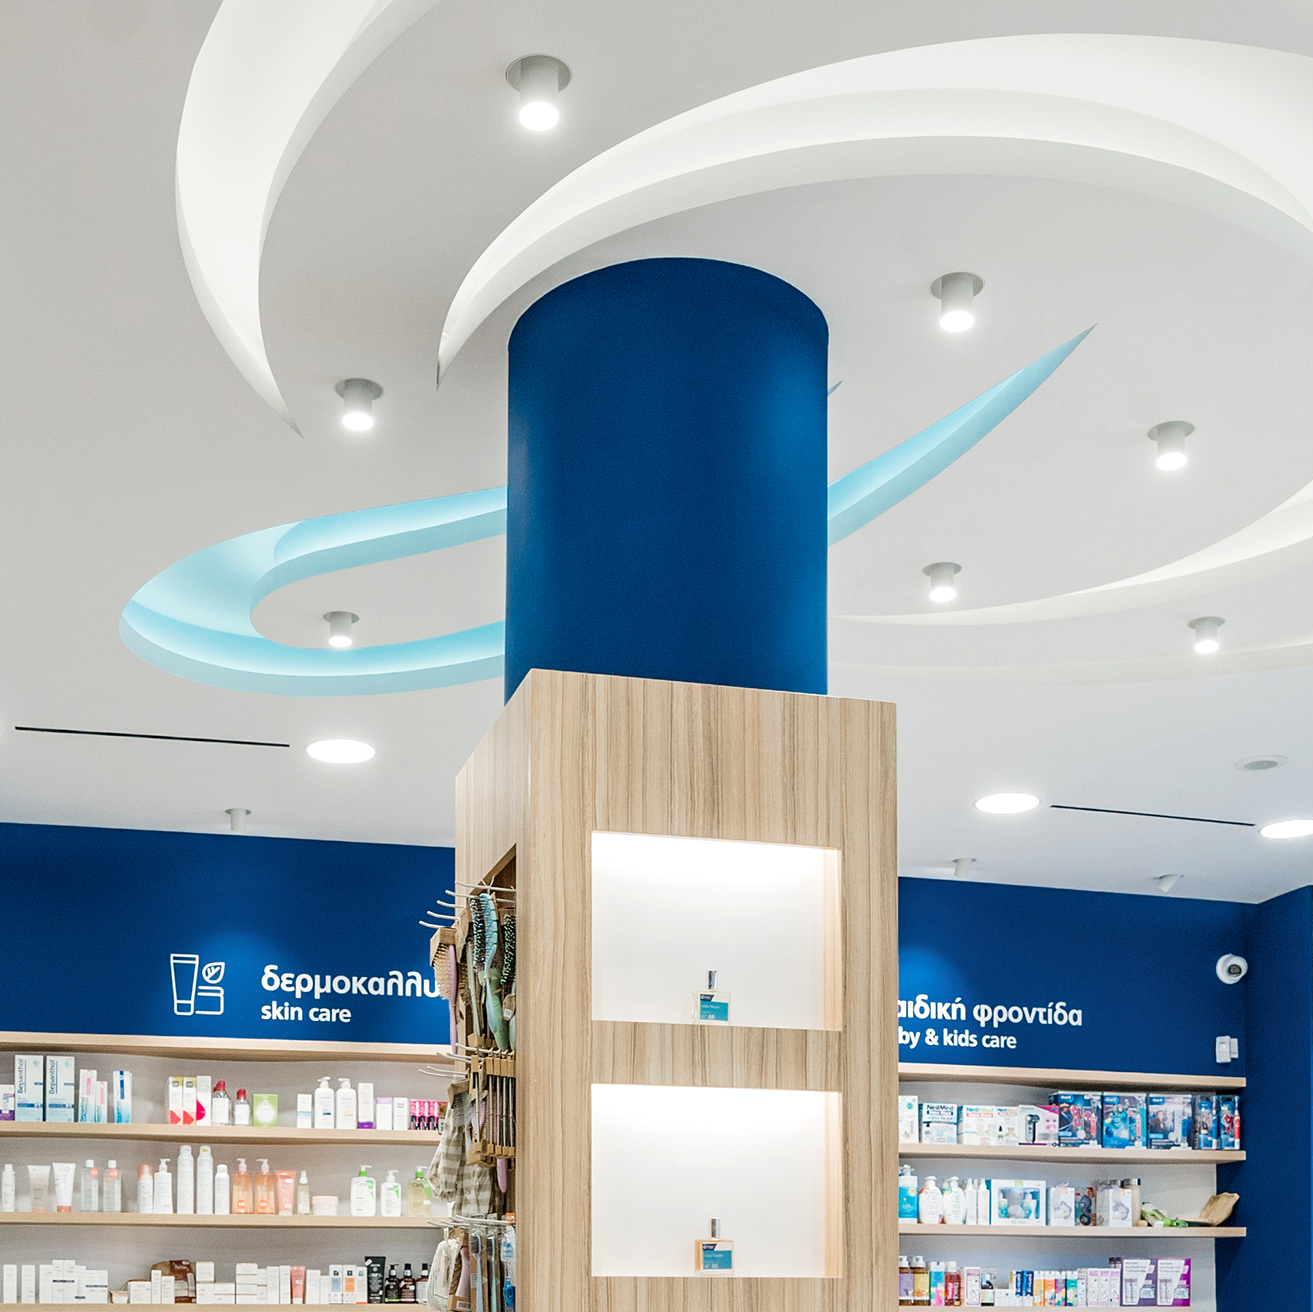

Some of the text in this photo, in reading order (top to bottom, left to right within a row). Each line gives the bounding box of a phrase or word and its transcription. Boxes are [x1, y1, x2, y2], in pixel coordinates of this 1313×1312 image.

[261, 1001, 351, 1023] skin care
[973, 1002, 1082, 1027] φροντίδα
[925, 1029, 939, 1045] &
[943, 1029, 978, 1047] kids
[982, 1032, 1017, 1049] care
